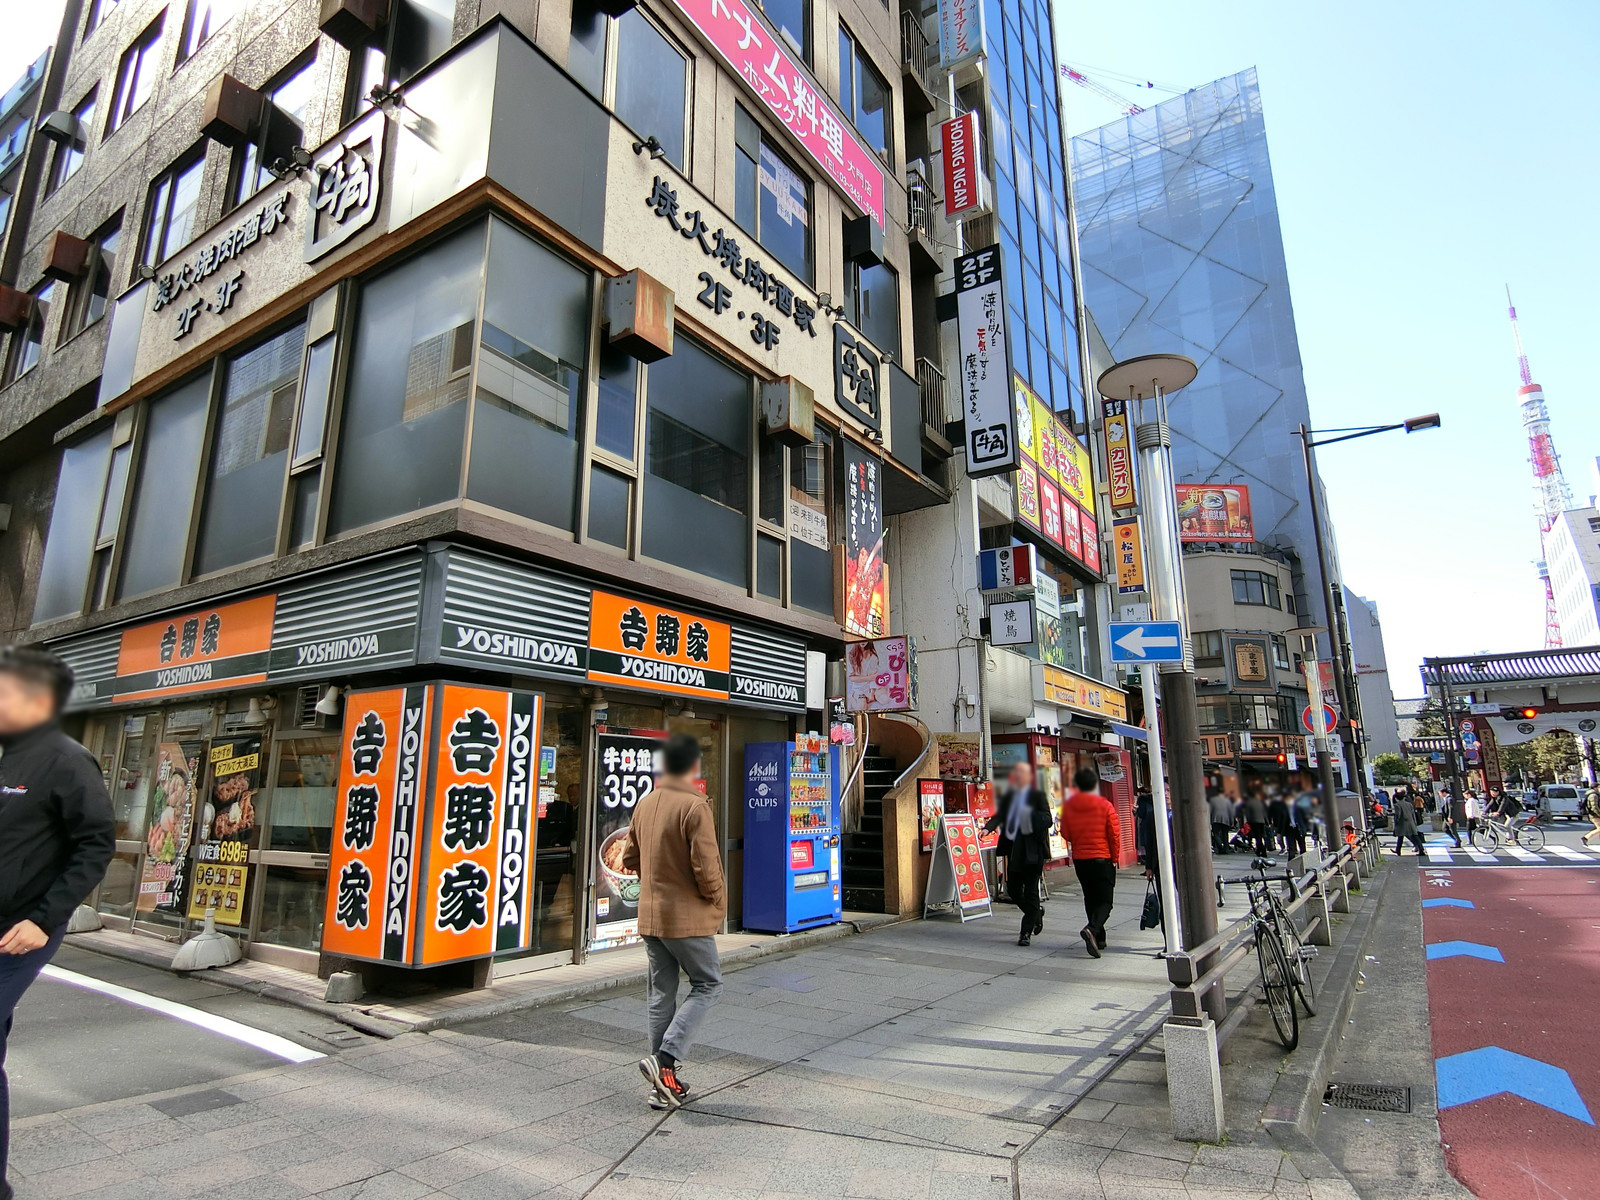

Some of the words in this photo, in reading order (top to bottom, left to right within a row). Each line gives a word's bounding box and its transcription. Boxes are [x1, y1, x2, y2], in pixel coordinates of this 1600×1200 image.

[950, 119, 965, 168] HOANG
[847, 159, 872, 197] 大門店
[953, 168, 968, 208] NGAN
[152, 190, 291, 312] 炭火焼肉酒家
[646, 174, 818, 338] 炭火焼肉酒家
[961, 250, 994, 274] 2F
[962, 266, 995, 289] 3F
[976, 328, 989, 380] 元気にする
[1110, 446, 1130, 500] カラオケ
[1187, 487, 1201, 503] 新
[1045, 509, 1059, 539] 3F
[1121, 541, 1134, 564] 松屋
[160, 612, 222, 665] 吉野家
[620, 606, 710, 663] 吉野家
[1003, 608, 1018, 638] 焼鳥
[297, 634, 379, 666] YOSHINOYA
[457, 626, 579, 667] YOSHINOYA
[156, 663, 213, 687] YOSHINOYA
[621, 656, 706, 687] YOSHINOYA
[735, 676, 799, 702] YOSHINOYA
[889, 652, 905, 704] ぴーち
[1088, 688, 1101, 708] 松屋
[159, 760, 172, 782] 新
[603, 746, 665, 774] 牛丼並
[748, 761, 778, 777] Asahi
[336, 709, 387, 931] 吉野家
[435, 707, 502, 934] 吉野家
[500, 712, 531, 926] YOSHINOYA
[748, 797, 778, 809] CALPIS
[387, 707, 422, 935] YOSHINOYA
